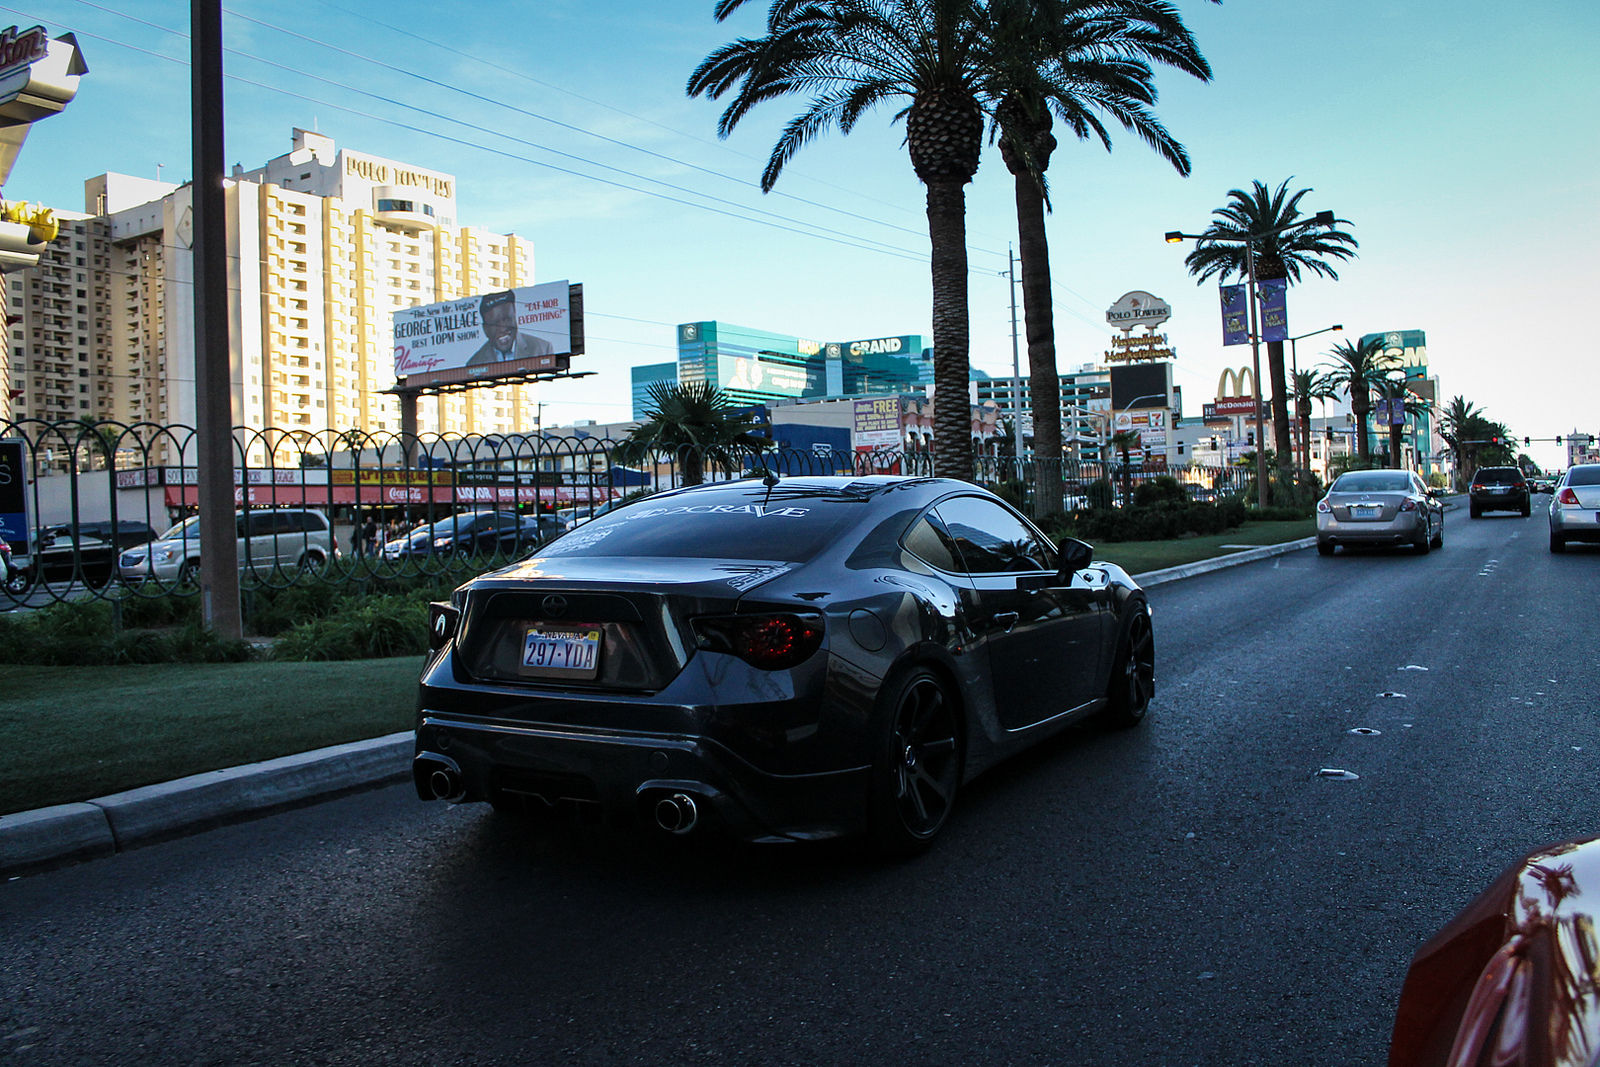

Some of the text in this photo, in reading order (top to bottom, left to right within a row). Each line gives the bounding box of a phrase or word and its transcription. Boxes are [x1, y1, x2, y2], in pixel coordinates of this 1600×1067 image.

[347, 156, 389, 183] POLO
[442, 304, 453, 313] Mr.
[1108, 308, 1167, 319] POLO TOWERS
[395, 310, 479, 339] GEORGE WALLACE
[1265, 319, 1285, 328] VEGAS
[412, 330, 479, 348] BEST 10PM SHOW!
[850, 338, 902, 355] GRAND
[394, 345, 445, 371] Flamingo
[873, 399, 898, 413] FREE
[456, 487, 492, 500] LIQUOR
